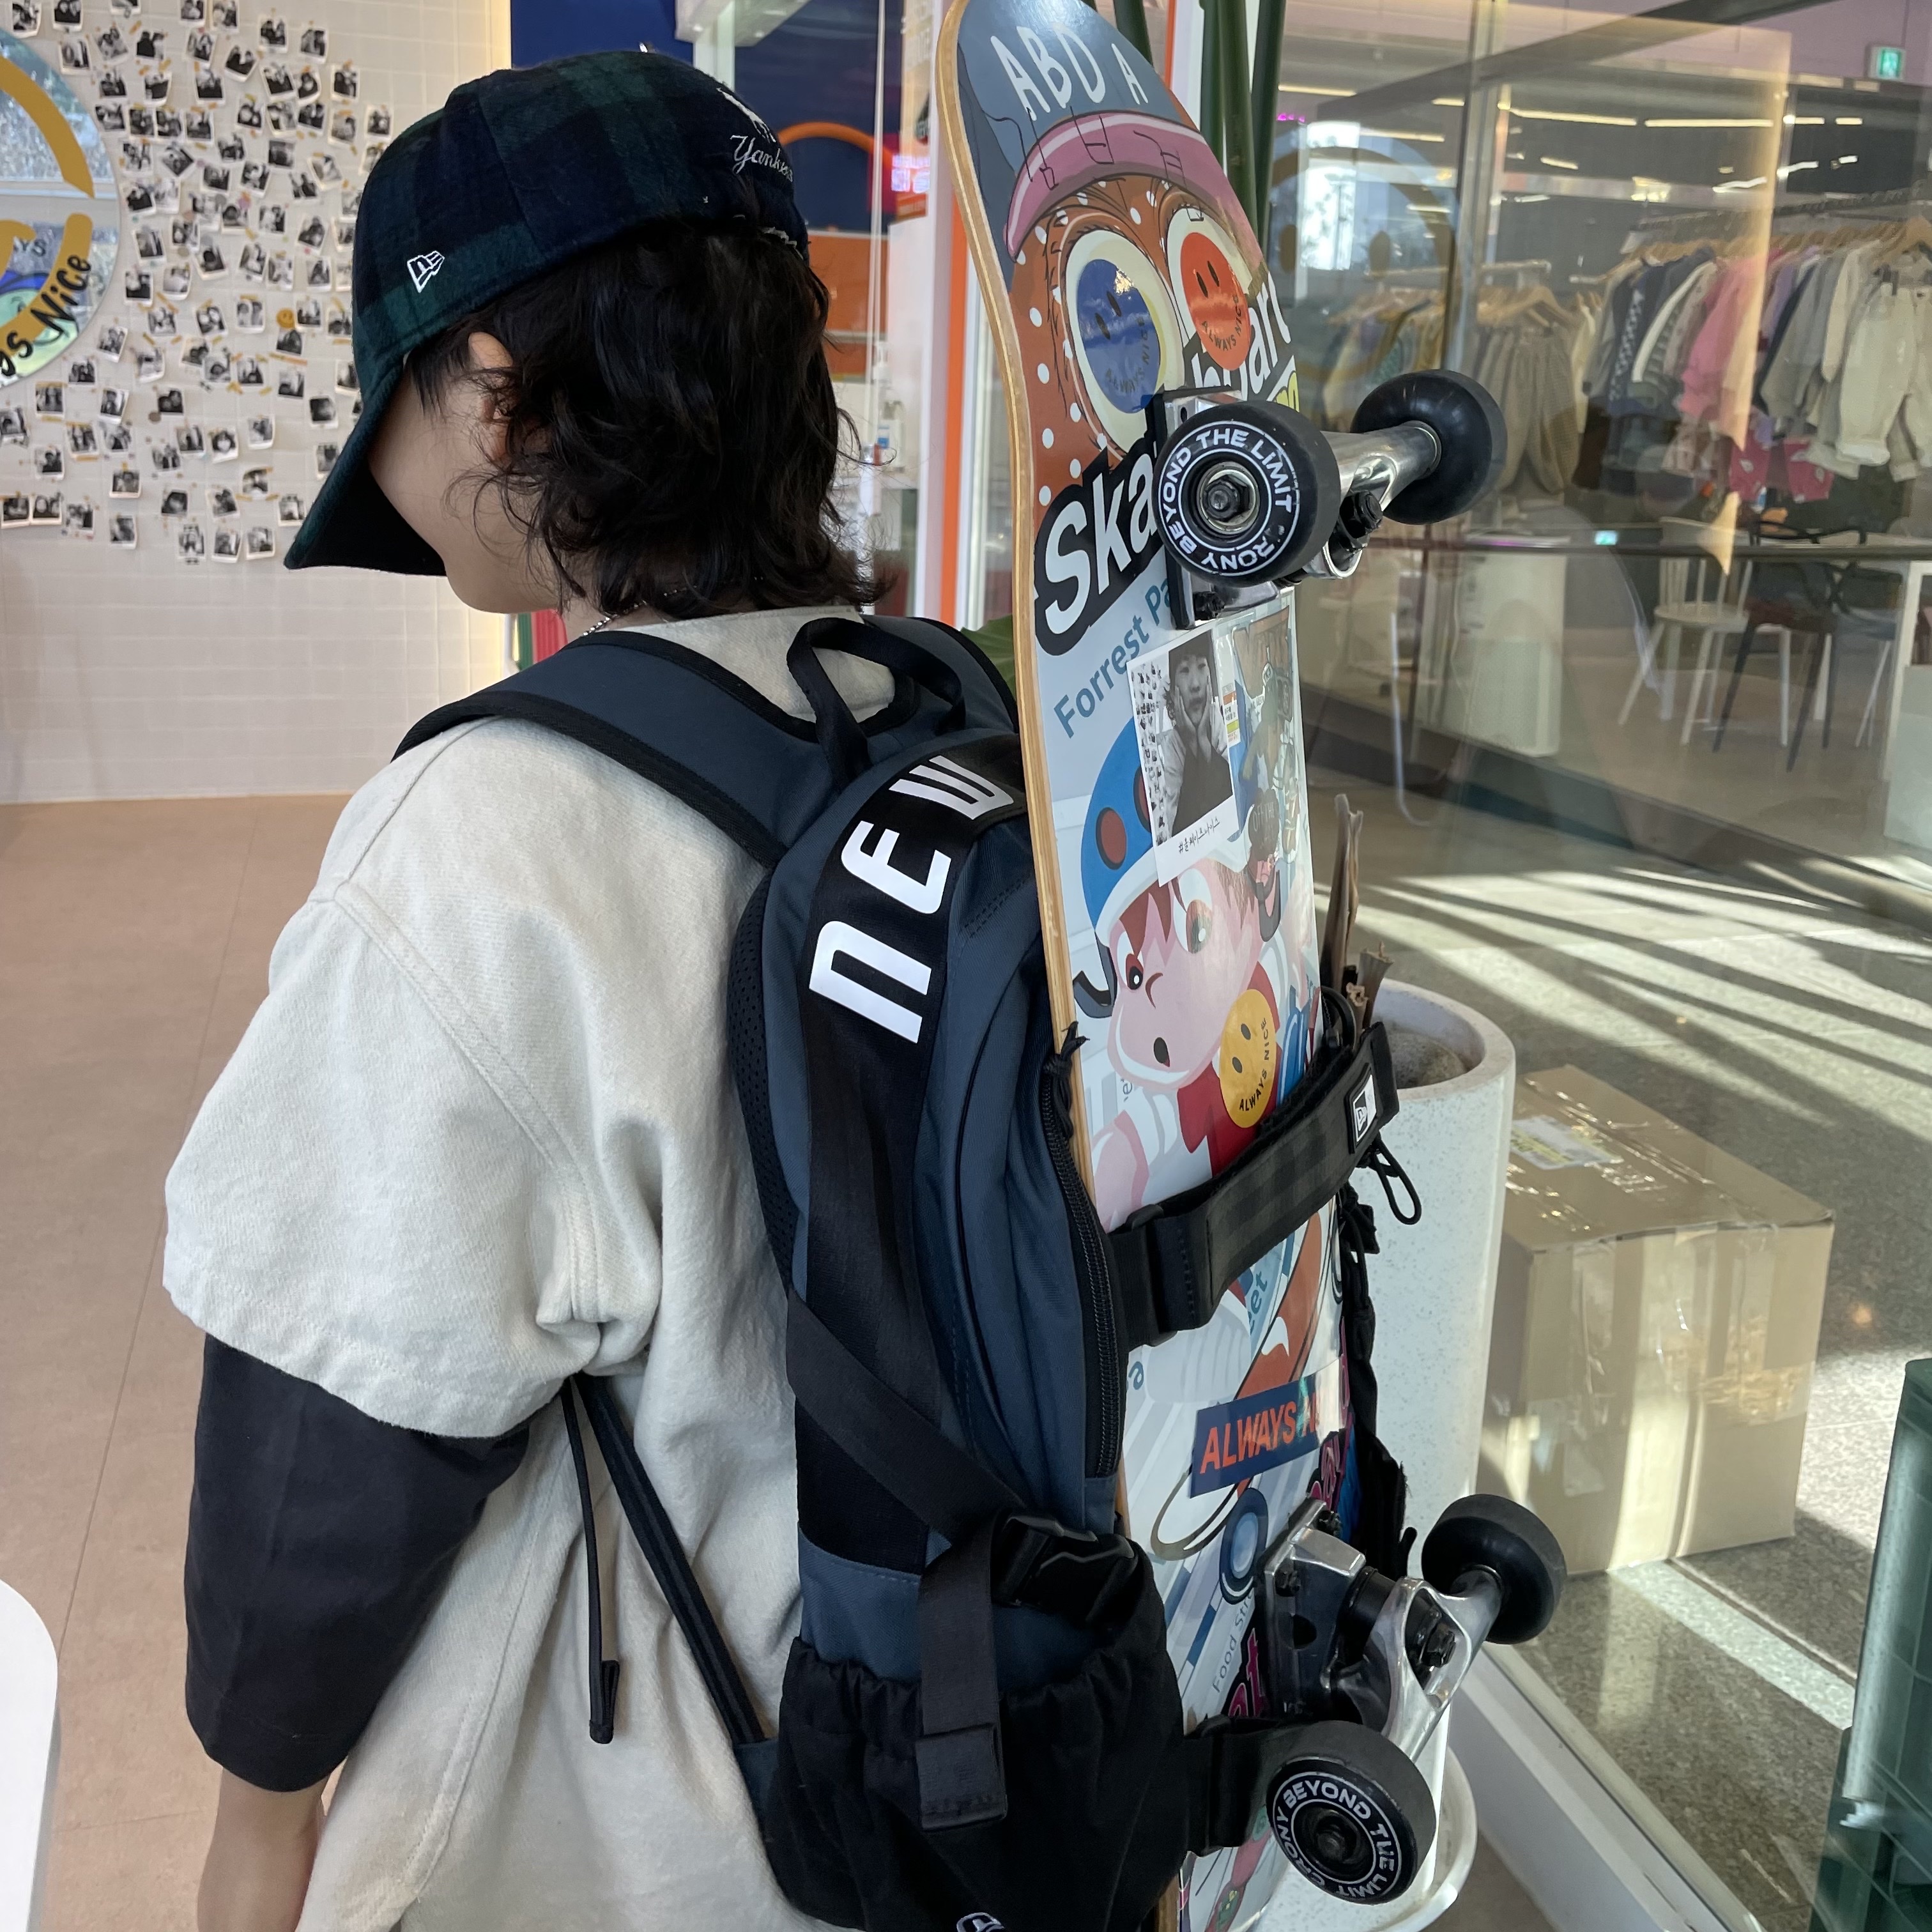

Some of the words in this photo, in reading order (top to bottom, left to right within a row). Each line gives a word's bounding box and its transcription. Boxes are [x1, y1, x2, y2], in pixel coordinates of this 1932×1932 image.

[31, 254, 91, 334] Nice
[1201, 320, 1237, 351] ALWAYS
[1163, 447, 1198, 555] BEYOND
[1195, 427, 1250, 449] THE
[1045, 452, 1159, 635] Ska
[1054, 615, 1150, 739] Forrest
[1239, 1068, 1268, 1112] ALWAYS
[1260, 1017, 1269, 1061] NICE
[1199, 1400, 1298, 1475] ALWAYS
[1212, 1634, 1237, 1693] Food
[1283, 1779, 1372, 1820] BEYOND
[1370, 1823, 1395, 1871] THE
